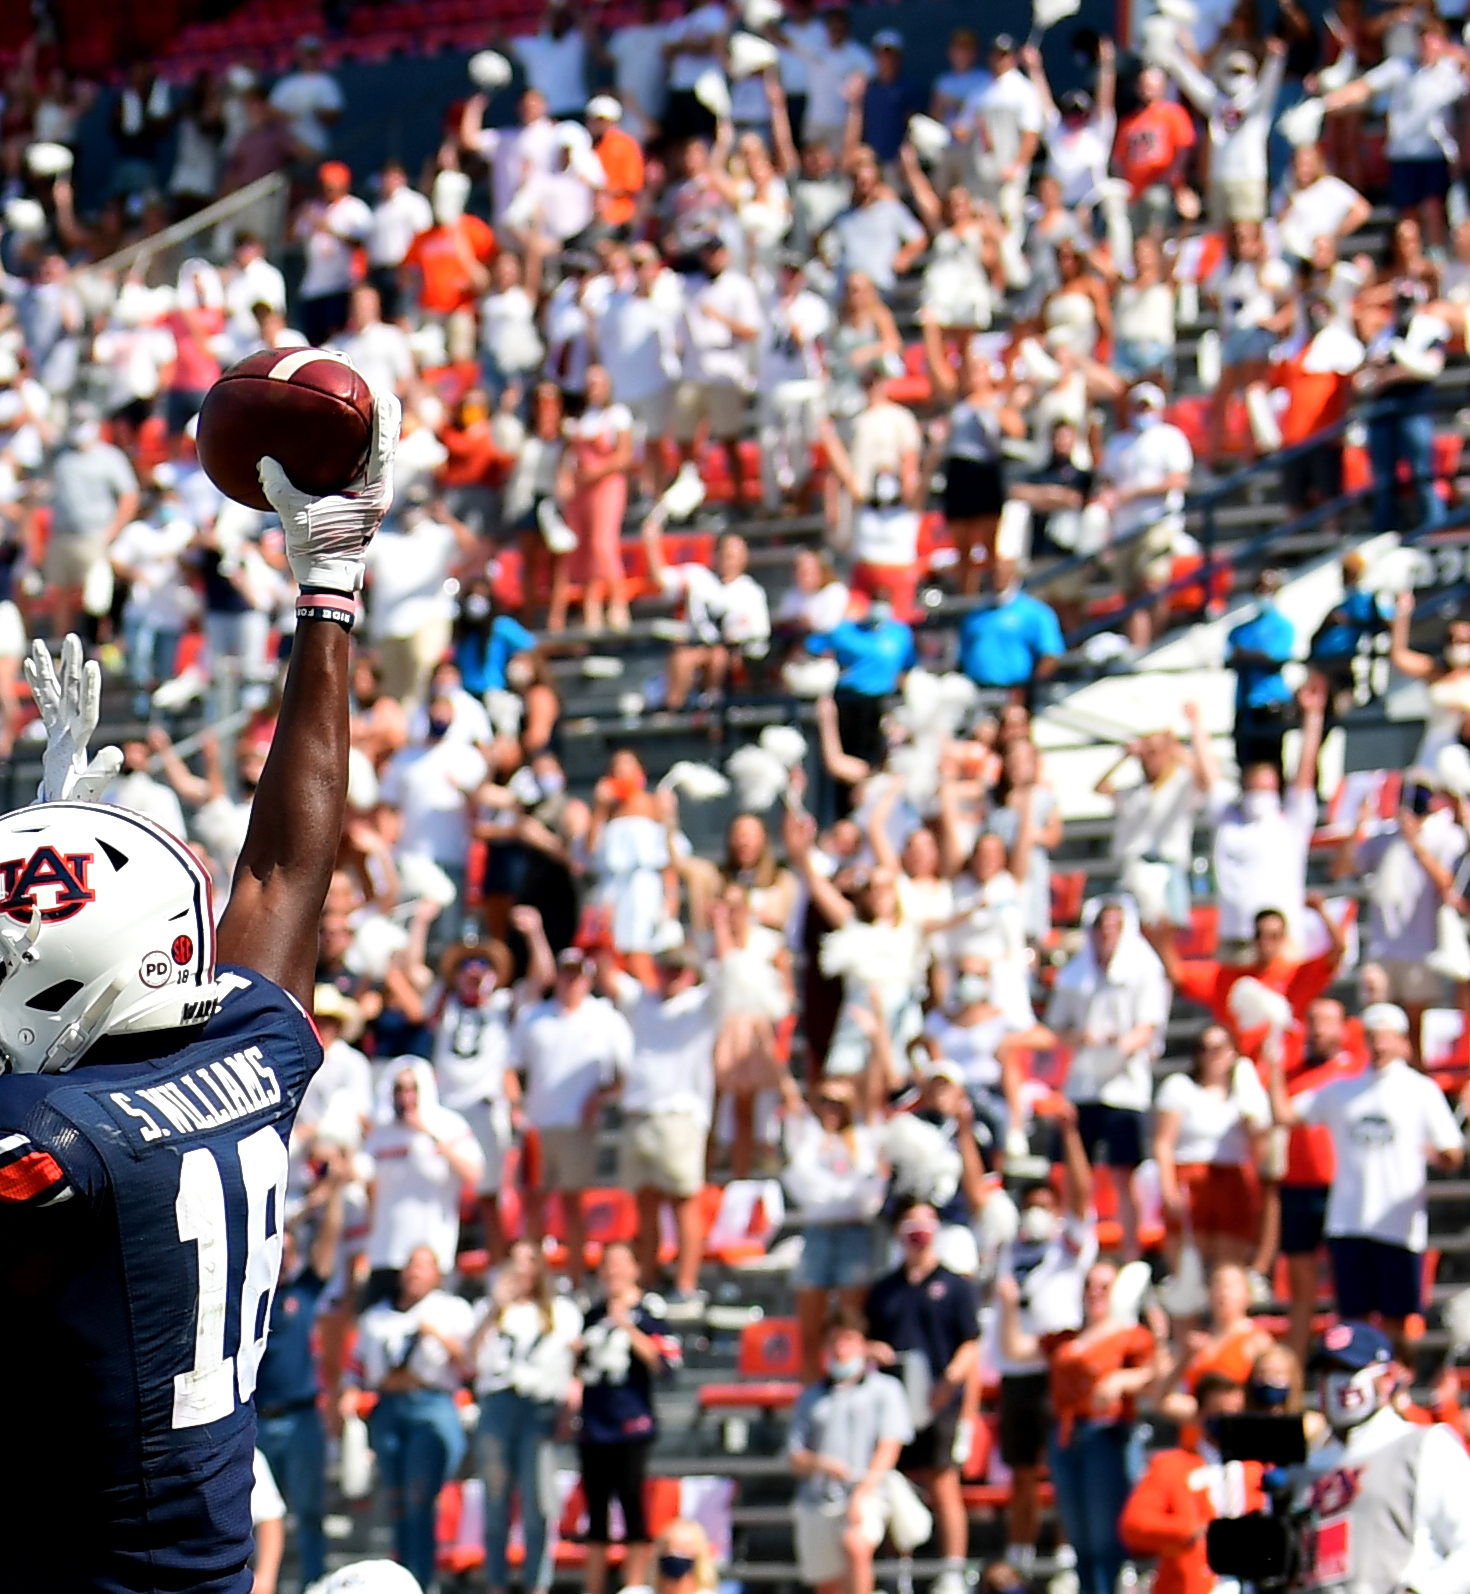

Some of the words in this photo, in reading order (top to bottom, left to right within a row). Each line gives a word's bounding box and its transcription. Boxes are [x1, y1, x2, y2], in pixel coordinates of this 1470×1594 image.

[146, 963, 167, 977] PD
[176, 969, 190, 985] 18
[172, 1124, 289, 1430] 18
